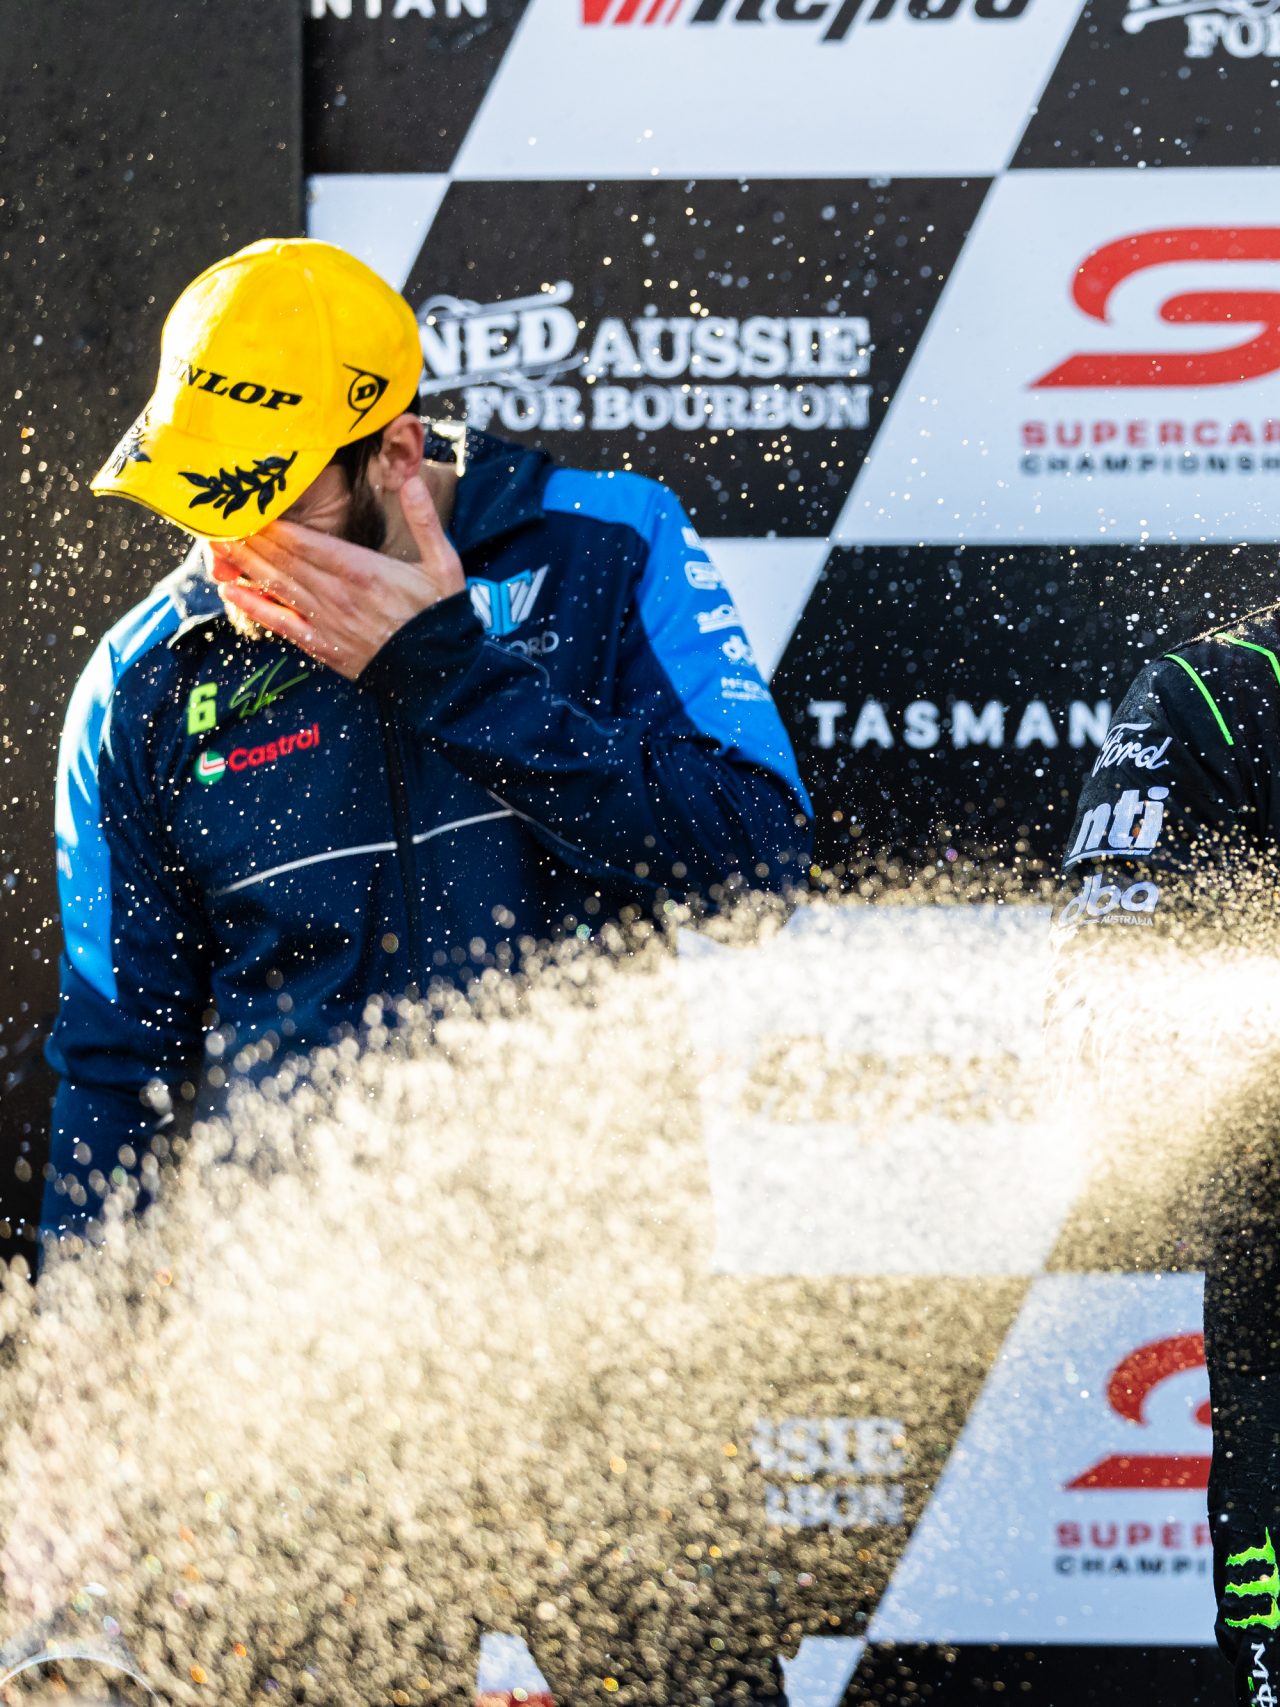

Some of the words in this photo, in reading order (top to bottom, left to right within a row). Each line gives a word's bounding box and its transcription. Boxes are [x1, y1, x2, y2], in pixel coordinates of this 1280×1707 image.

[582, 316, 871, 379] AUSSIE
[464, 384, 584, 432] FOR
[592, 384, 873, 432] BOURBON
[187, 681, 219, 736] 6
[227, 723, 321, 773] Castrol
[1091, 721, 1173, 778] Ford
[1101, 914, 1154, 927] AUSTRALIA
